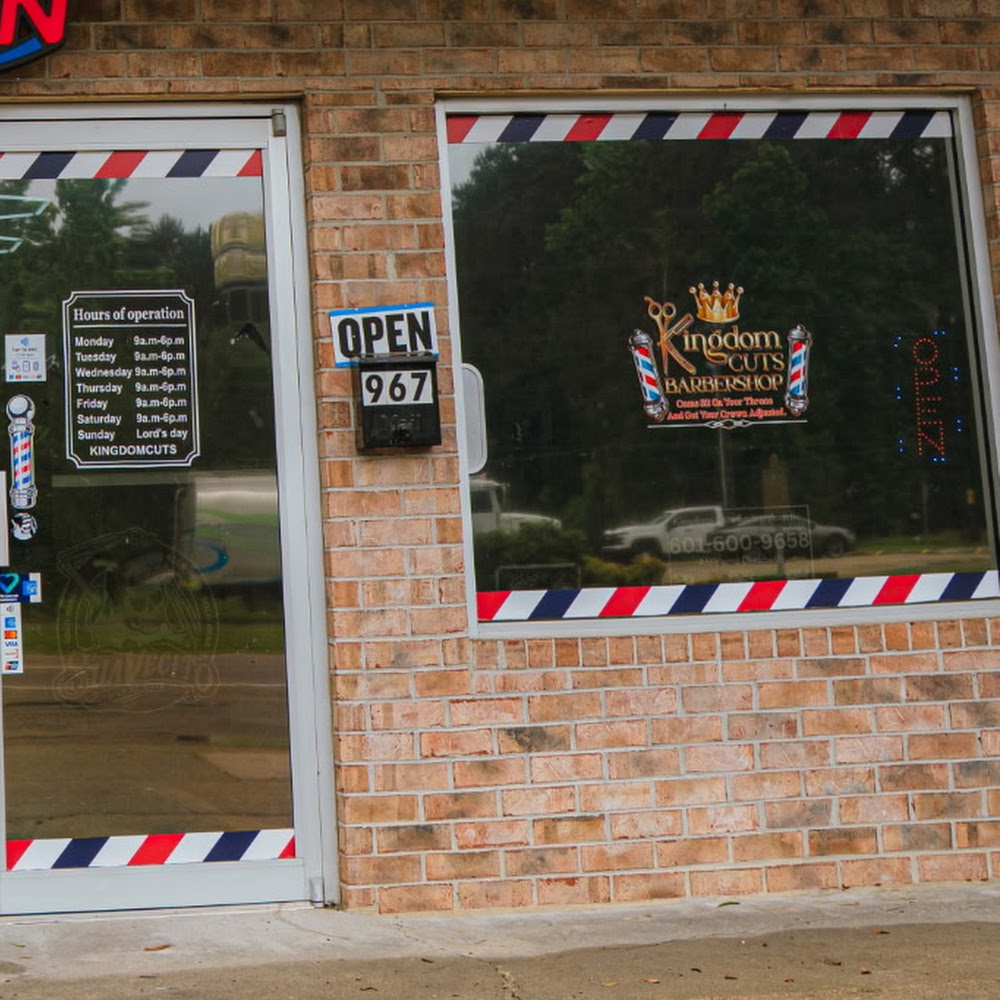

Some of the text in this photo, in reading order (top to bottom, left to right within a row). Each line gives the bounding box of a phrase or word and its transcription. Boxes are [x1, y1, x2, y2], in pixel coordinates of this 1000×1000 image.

[73, 306, 185, 323] Hours of operation
[75, 336, 114, 348] Monday
[337, 311, 434, 359] OPEN
[644, 297, 783, 376] Kingdom
[75, 352, 117, 363] Tuesday
[728, 352, 786, 373] CUTS
[75, 367, 133, 379] Wednesday
[76, 383, 123, 394] Thursday
[365, 372, 428, 404] 967
[663, 374, 784, 394] BARBERSHOP
[76, 399, 108, 410] Friday
[913, 337, 945, 457] OPEN
[77, 414, 122, 426] Saturday
[77, 428, 188, 441] Sunday Lord's day
[89, 444, 177, 456] KINGDOMCUTS
[670, 531, 811, 553] 601-600-9658
